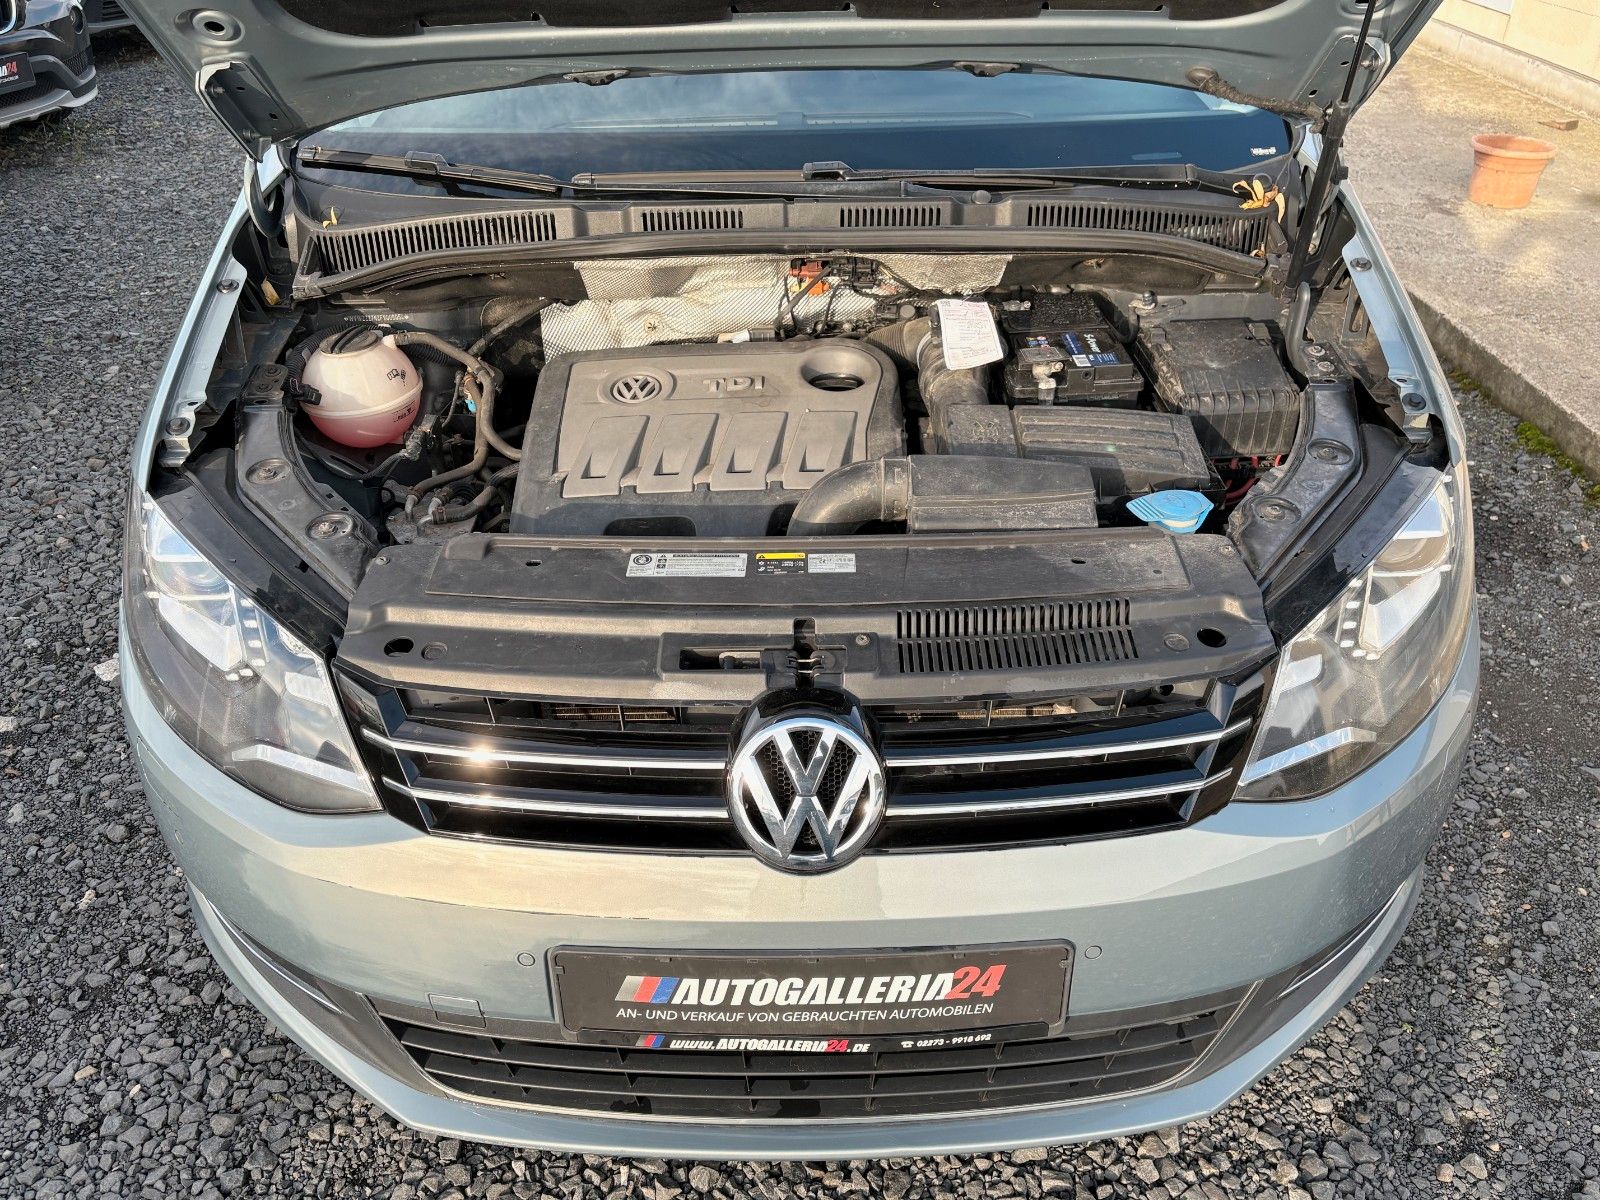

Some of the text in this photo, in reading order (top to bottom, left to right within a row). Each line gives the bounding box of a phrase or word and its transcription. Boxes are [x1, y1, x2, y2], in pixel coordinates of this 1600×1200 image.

[703, 375, 766, 393] TDI
[671, 965, 1007, 1006] AUTOGALLERIA24
[615, 1003, 994, 1023] AN- UND VERKAUF VON GEBRAUCHTEN AUTOMOBILEN
